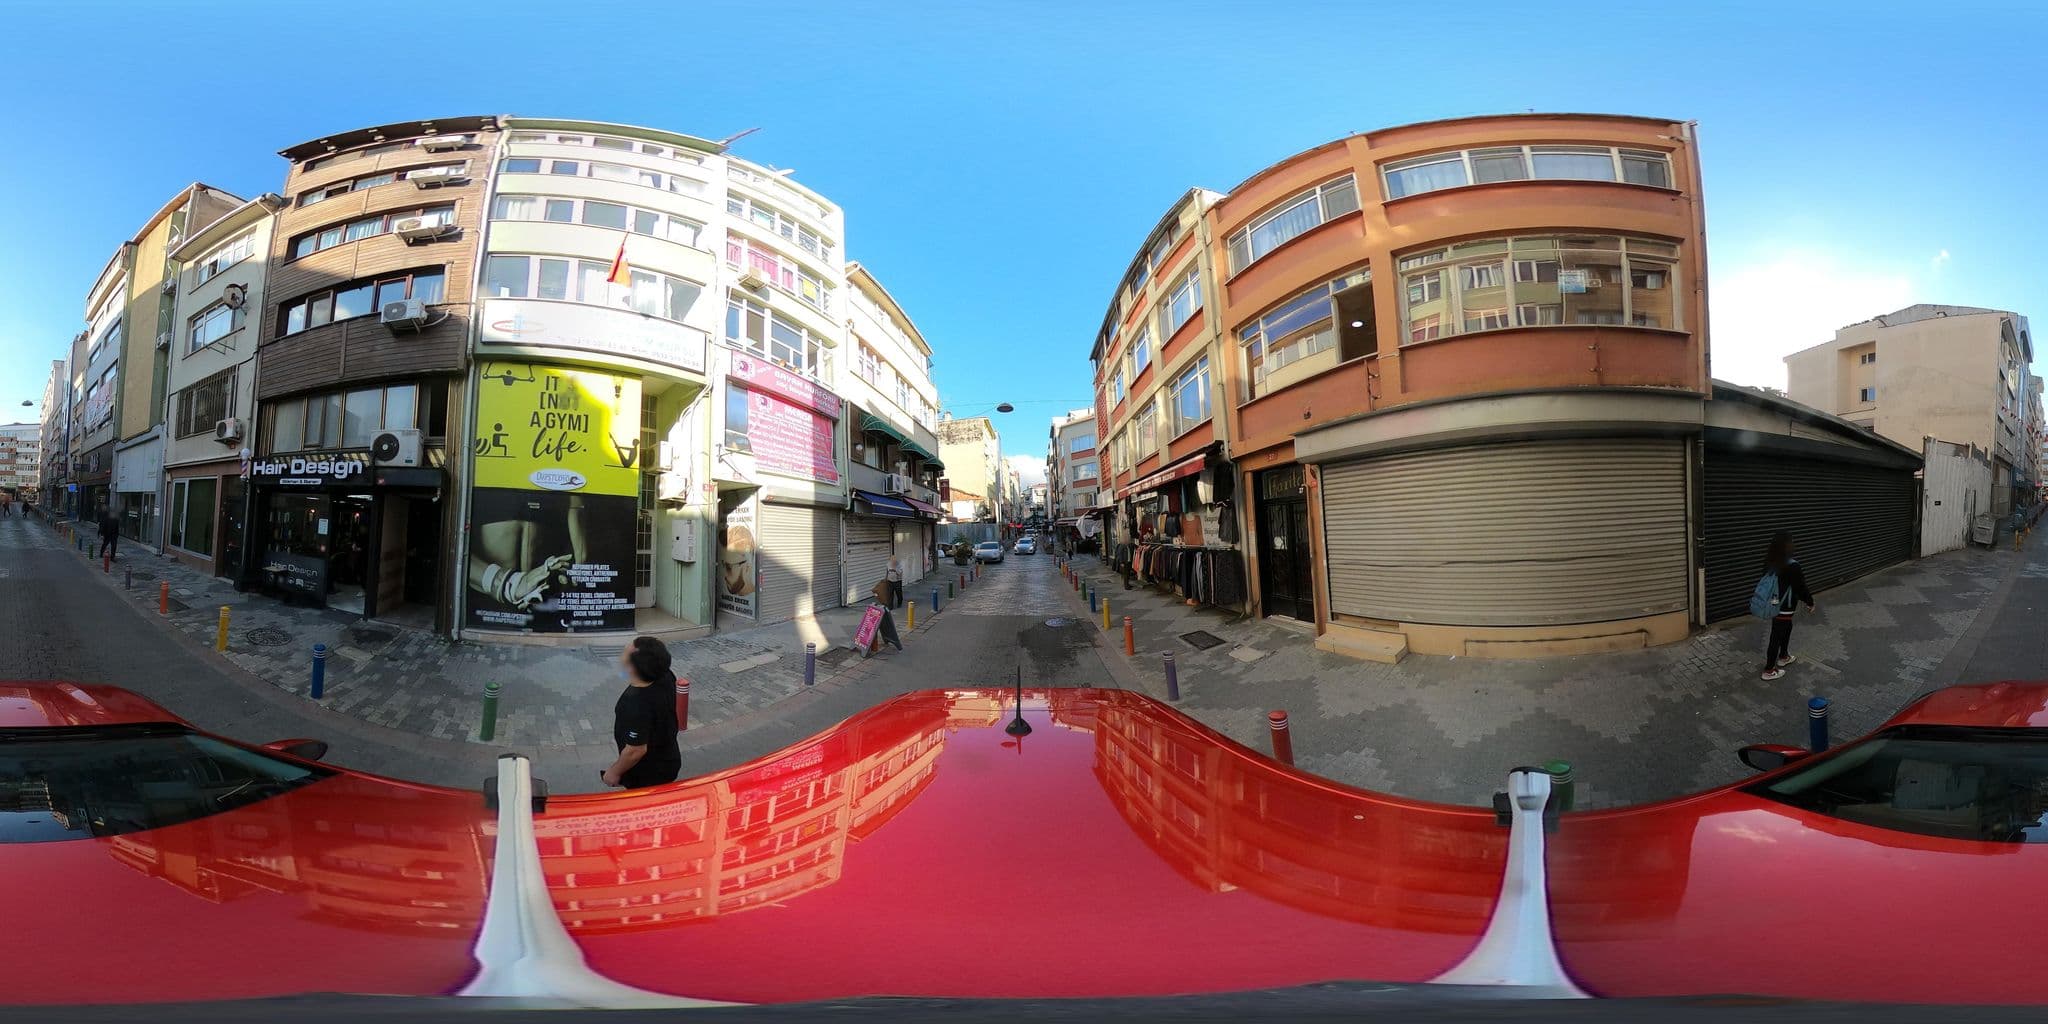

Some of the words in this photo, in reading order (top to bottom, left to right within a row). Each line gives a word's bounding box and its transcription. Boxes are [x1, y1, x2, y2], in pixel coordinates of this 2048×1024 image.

[545, 375, 560, 391] IT
[530, 411, 541, 427] A
[545, 412, 588, 433] GYM]
[252, 460, 288, 475] Hair
[290, 458, 362, 479] Design
